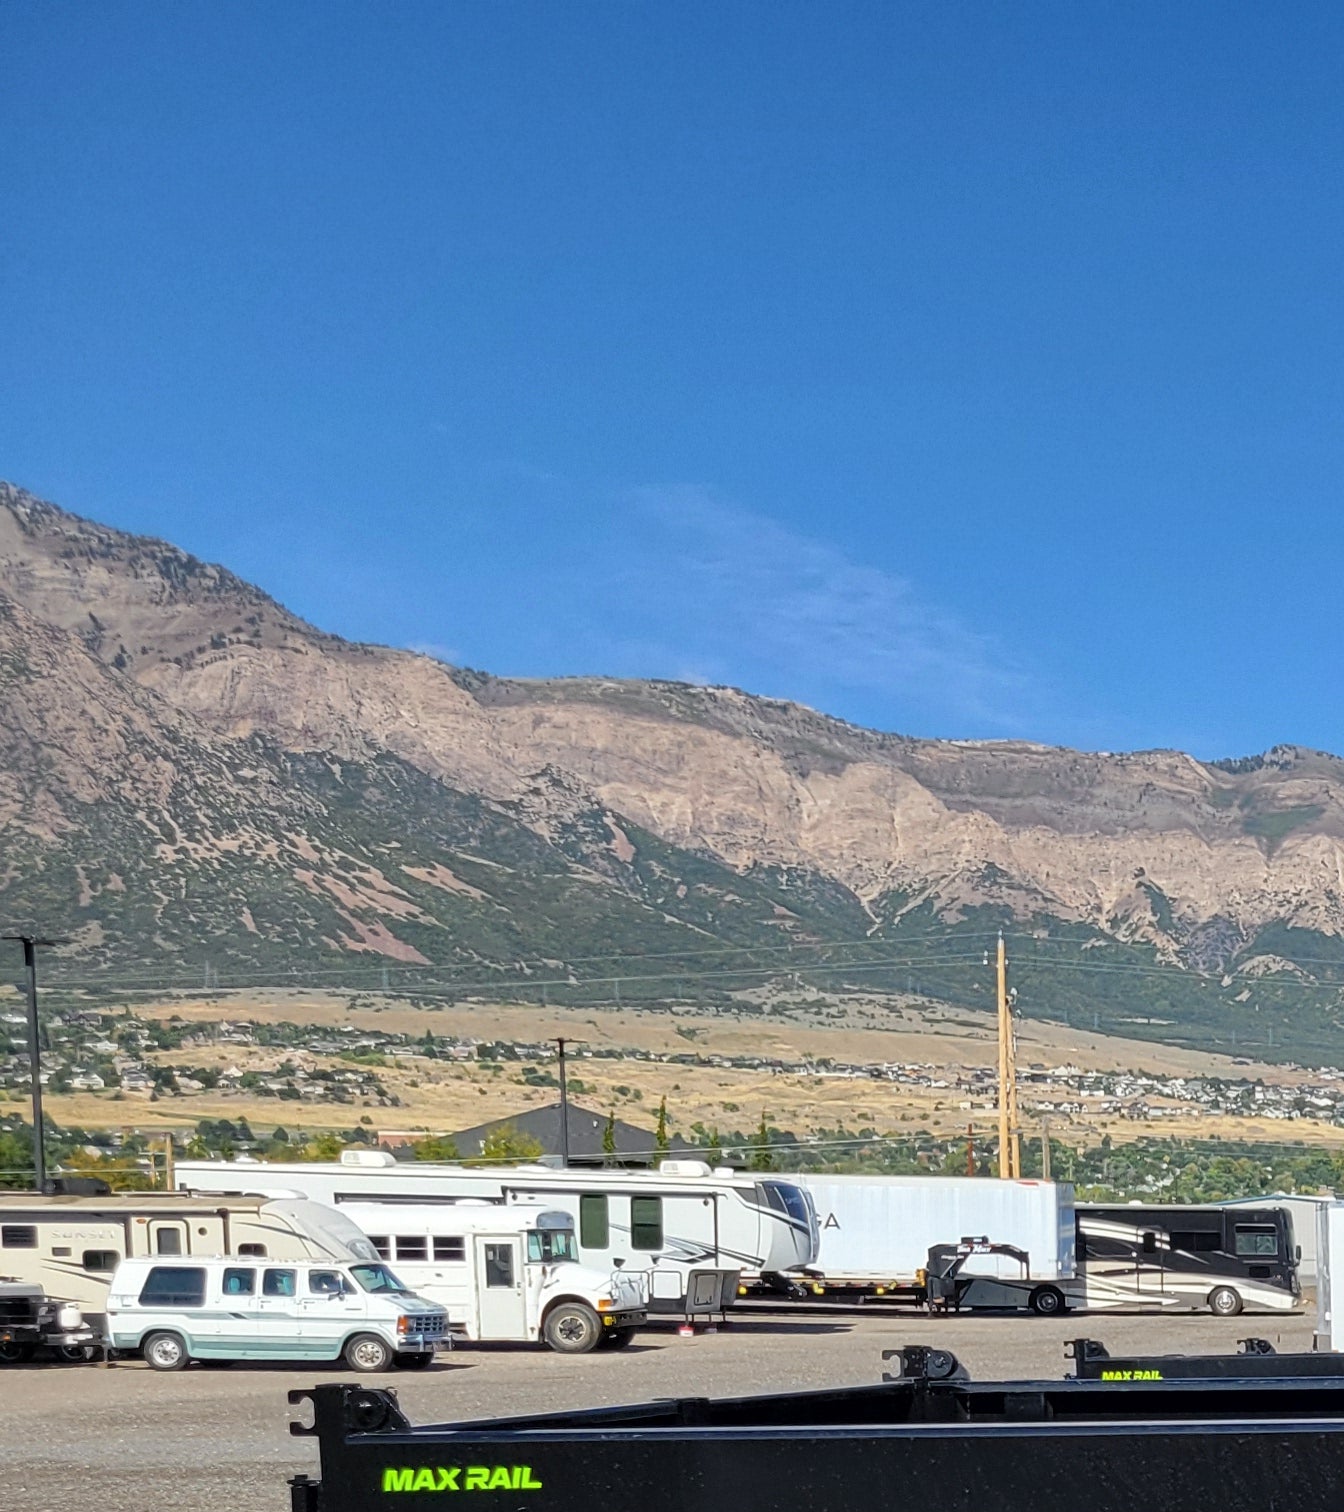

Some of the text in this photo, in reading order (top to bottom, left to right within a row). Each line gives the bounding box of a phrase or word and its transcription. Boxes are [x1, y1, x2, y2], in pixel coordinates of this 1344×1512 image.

[1102, 1370, 1163, 1380] MAX RAIL
[384, 1466, 543, 1491] MAX RAIL
